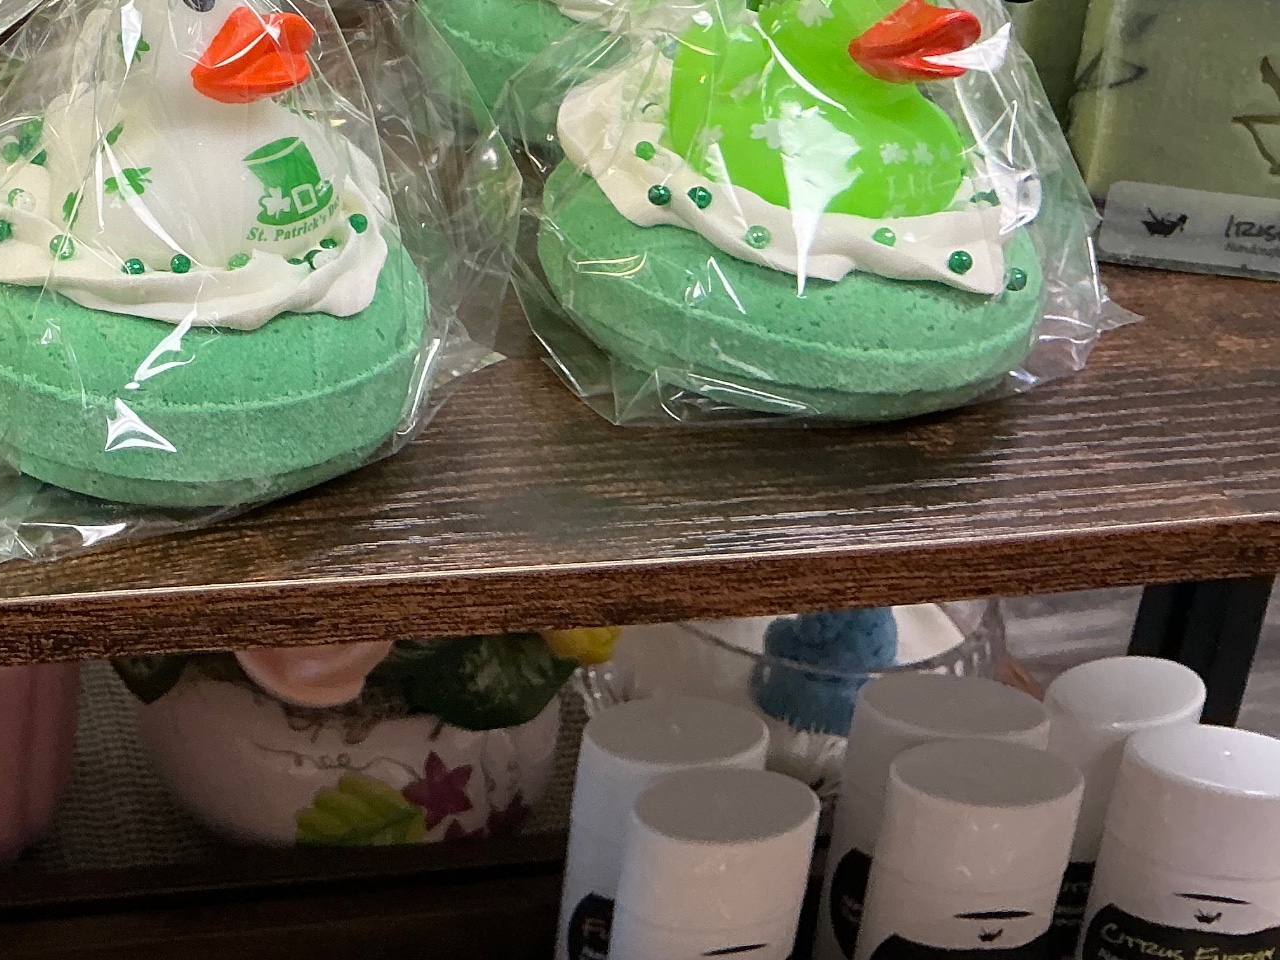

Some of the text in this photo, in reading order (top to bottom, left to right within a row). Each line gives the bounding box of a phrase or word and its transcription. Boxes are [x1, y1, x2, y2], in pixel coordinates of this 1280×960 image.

[246, 226, 269, 242] St.
[273, 214, 328, 242] Patrick's
[1223, 214, 1280, 242] IRIS
